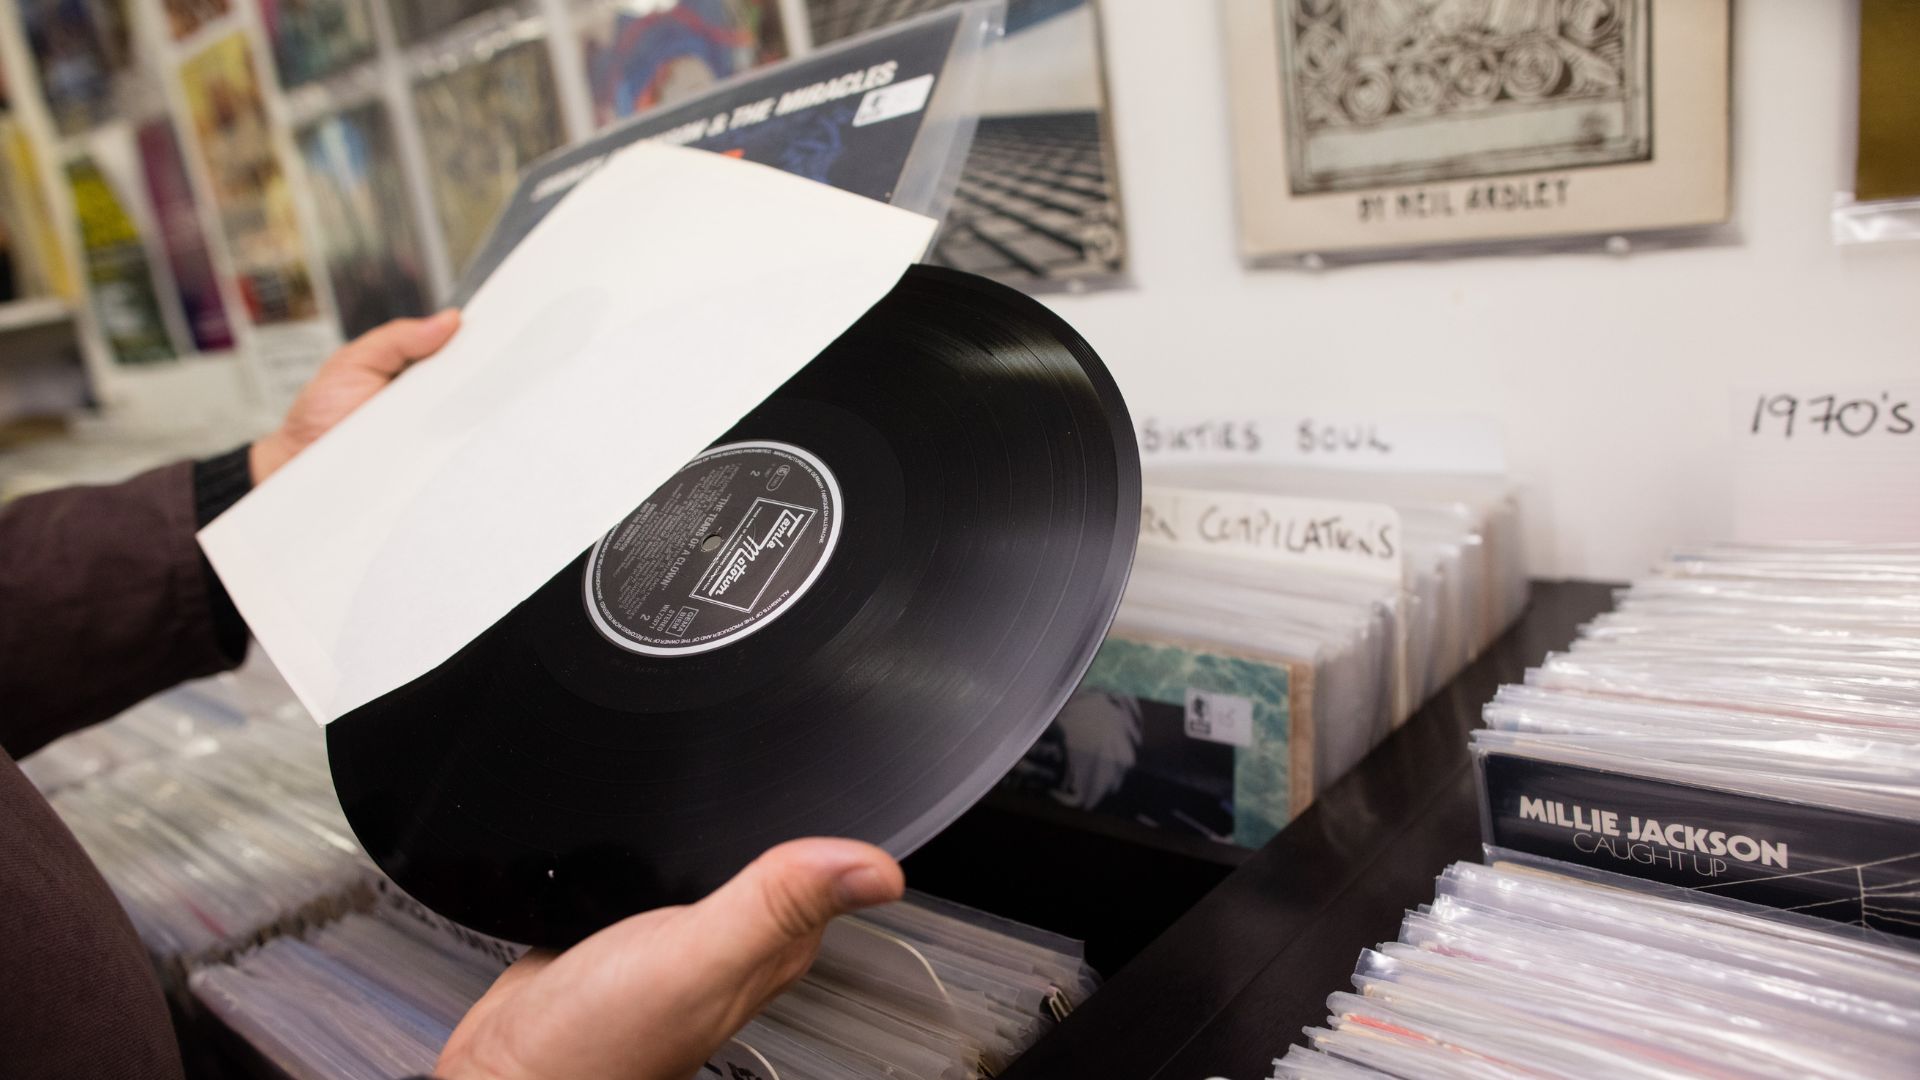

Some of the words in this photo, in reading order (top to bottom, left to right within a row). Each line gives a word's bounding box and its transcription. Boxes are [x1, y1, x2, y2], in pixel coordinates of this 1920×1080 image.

[706, 112, 729, 137] &
[729, 97, 776, 129] THE
[774, 60, 899, 118] MIRACLES
[1358, 194, 1386, 224] BY
[1396, 191, 1455, 219] NEIL
[1465, 178, 1570, 212] ARDLEY
[1752, 391, 1915, 439] 1970's
[1297, 418, 1394, 455] SOUL
[688, 537, 699, 549] OF
[695, 513, 718, 537] TEARS
[758, 509, 804, 549] Tamla
[1199, 504, 1397, 560] COMPILATIONS
[708, 535, 769, 597] Motown
[656, 609, 675, 632] STEREO
[671, 612, 687, 629] BIEM
[677, 611, 696, 632] GEMA
[712, 622, 744, 638] PRODUCER
[1519, 794, 1620, 838] MILLIE
[1626, 815, 1789, 869] JACKSON
[1573, 832, 1687, 872] CAUGHT
[1694, 852, 1727, 878] UP
